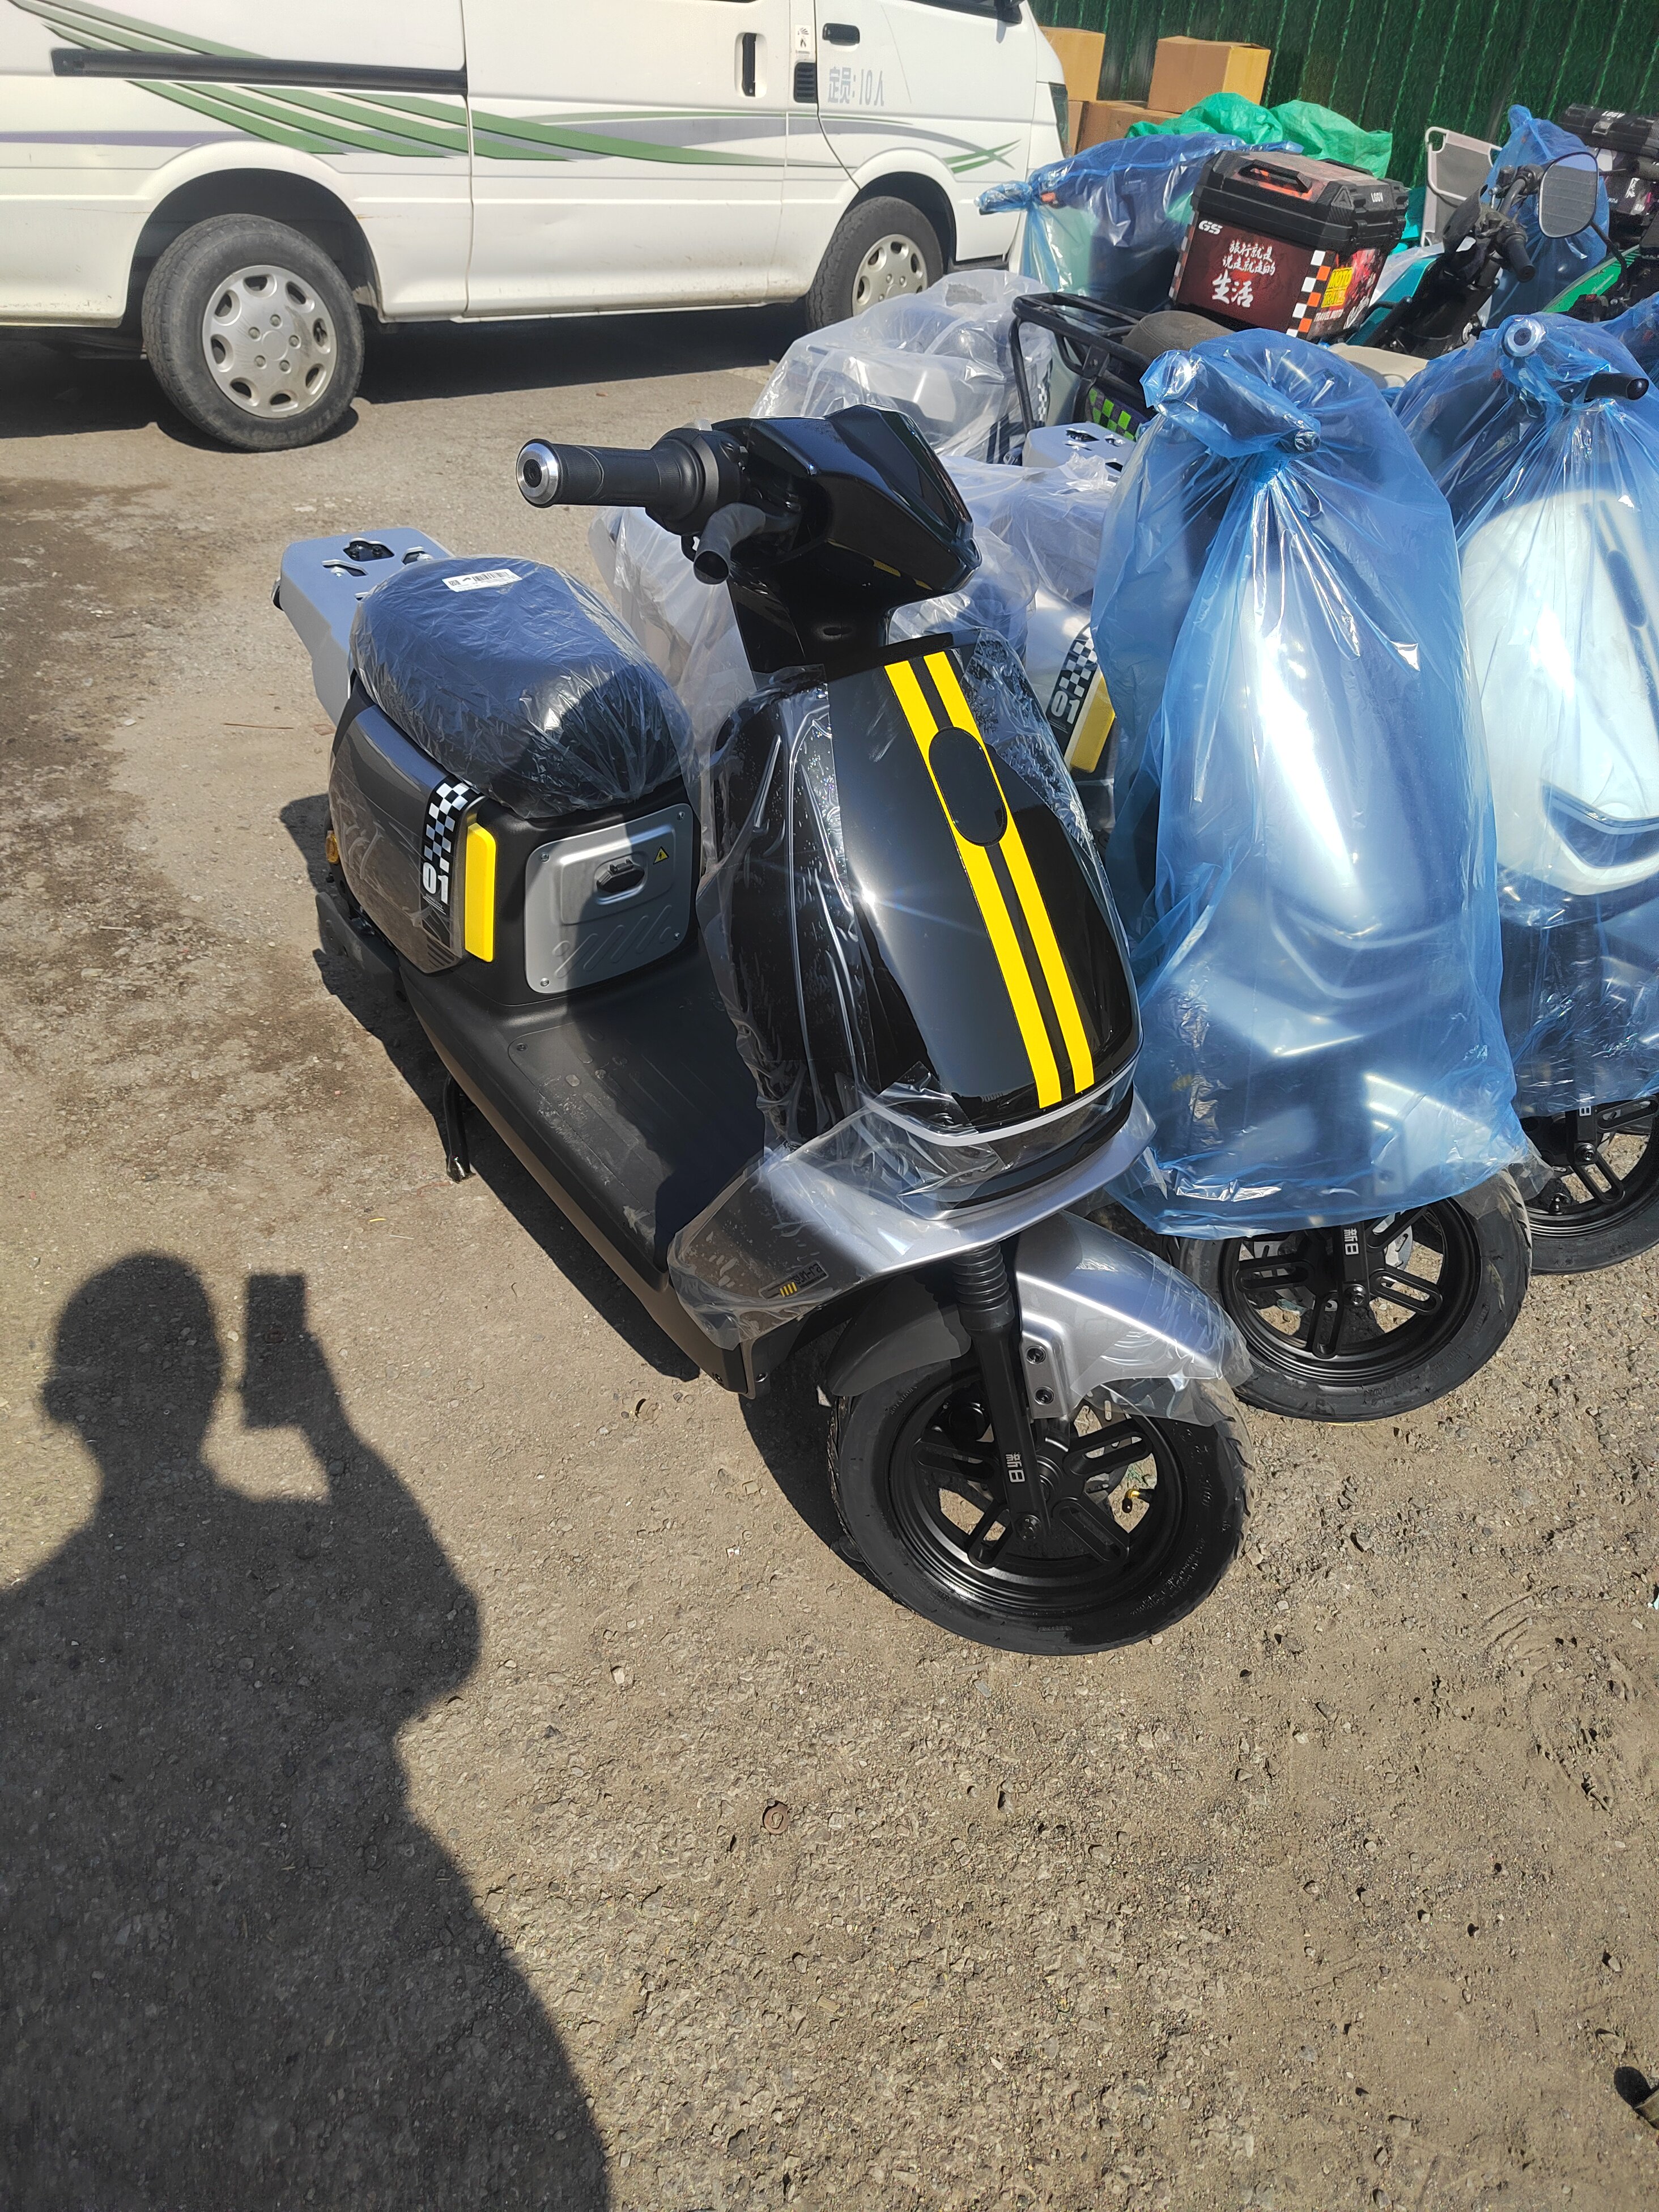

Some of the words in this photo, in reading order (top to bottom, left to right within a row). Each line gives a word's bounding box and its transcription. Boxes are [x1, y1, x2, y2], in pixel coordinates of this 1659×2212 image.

[828, 66, 884, 107] 定员:10人
[1198, 220, 1223, 235] GS
[1228, 239, 1273, 263] 旅行就是
[1211, 269, 1254, 308] 生活
[1050, 690, 1081, 724] 01
[423, 862, 449, 905] 01
[1343, 1227, 1359, 1255] 新日
[1005, 1452, 1025, 1482] 新日
